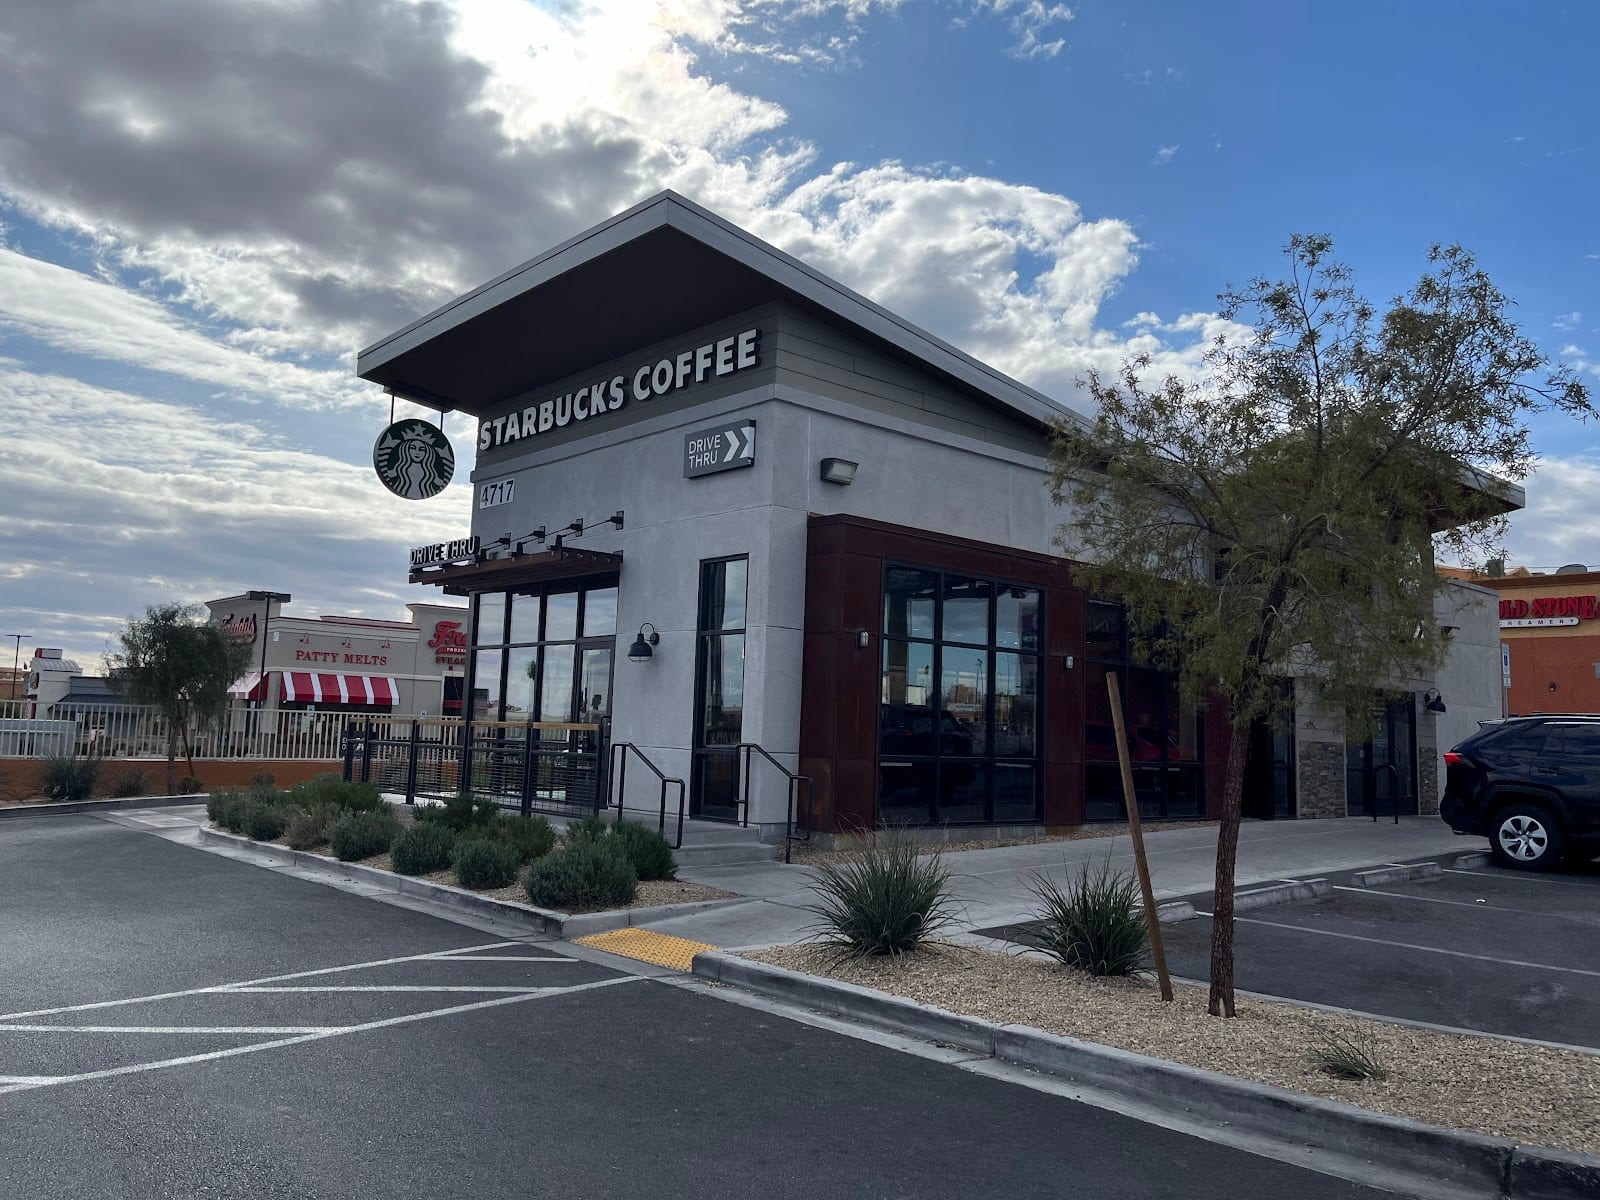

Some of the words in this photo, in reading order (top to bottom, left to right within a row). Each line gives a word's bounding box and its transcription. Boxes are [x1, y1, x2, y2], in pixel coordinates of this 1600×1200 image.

[479, 376, 625, 450] STARBUCKS
[633, 328, 757, 401] COFFEE
[688, 434, 721, 455] DRIVE
[688, 450, 718, 469] THRU
[482, 479, 514, 507] 4717
[410, 542, 442, 565] DRIVE
[445, 535, 476, 561] THRU
[1532, 595, 1596, 619] STONE
[295, 650, 339, 663] PATTY
[343, 653, 387, 666] MELTS
